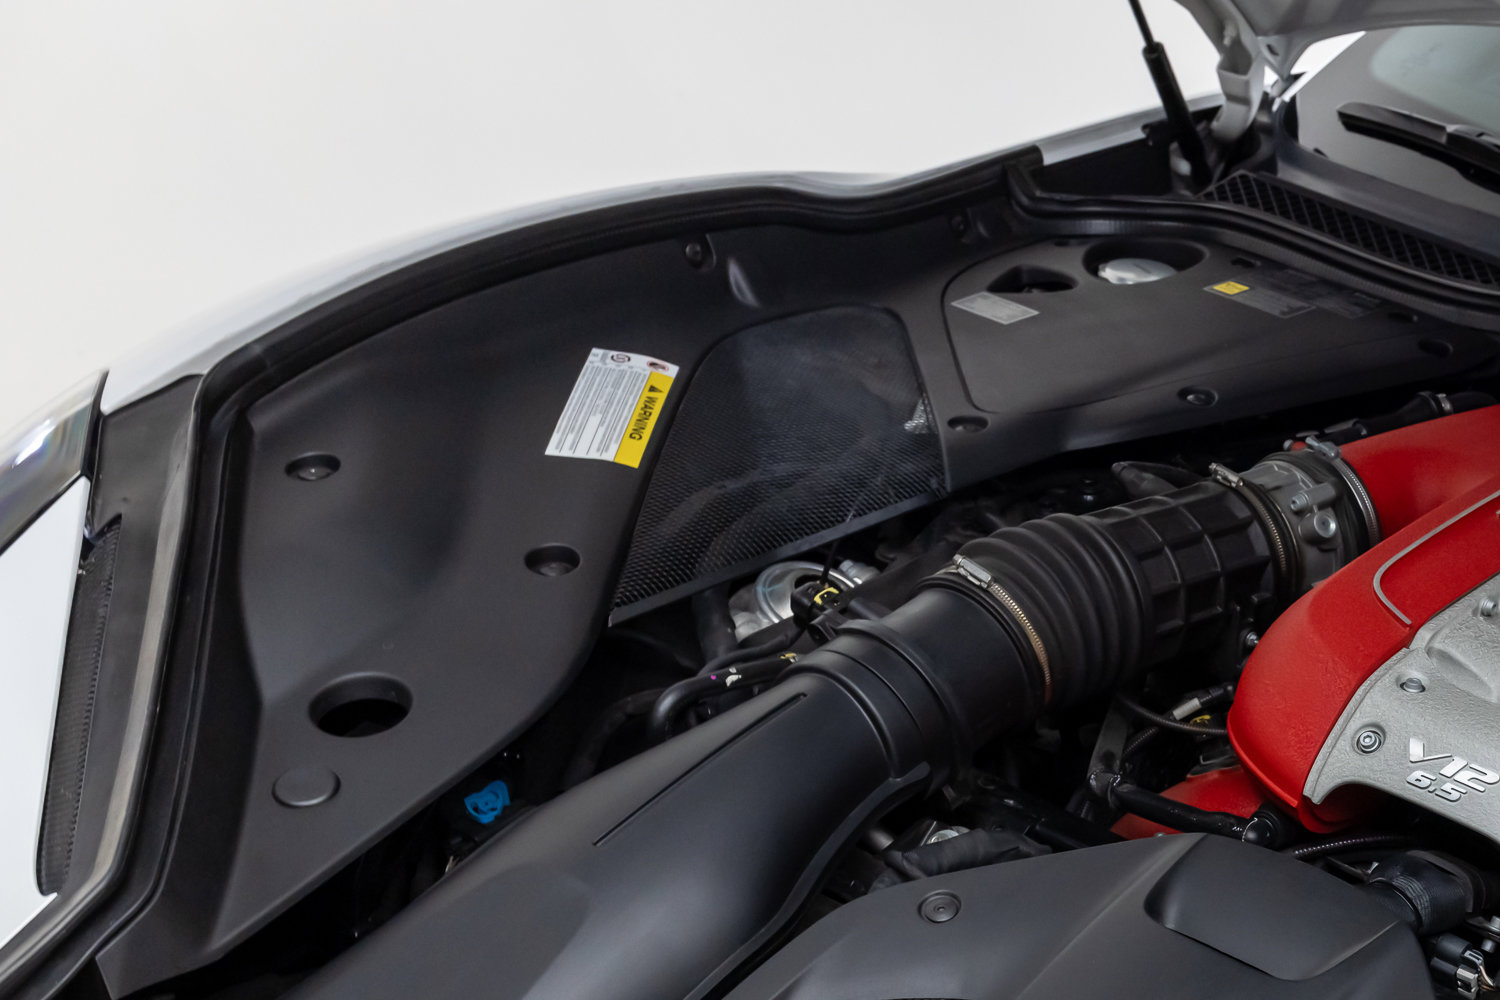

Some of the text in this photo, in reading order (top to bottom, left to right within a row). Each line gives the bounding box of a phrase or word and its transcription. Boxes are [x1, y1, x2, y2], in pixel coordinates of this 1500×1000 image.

[629, 396, 659, 441] WARNING
[1406, 770, 1468, 803] 6.5
[1409, 737, 1500, 793] V12
